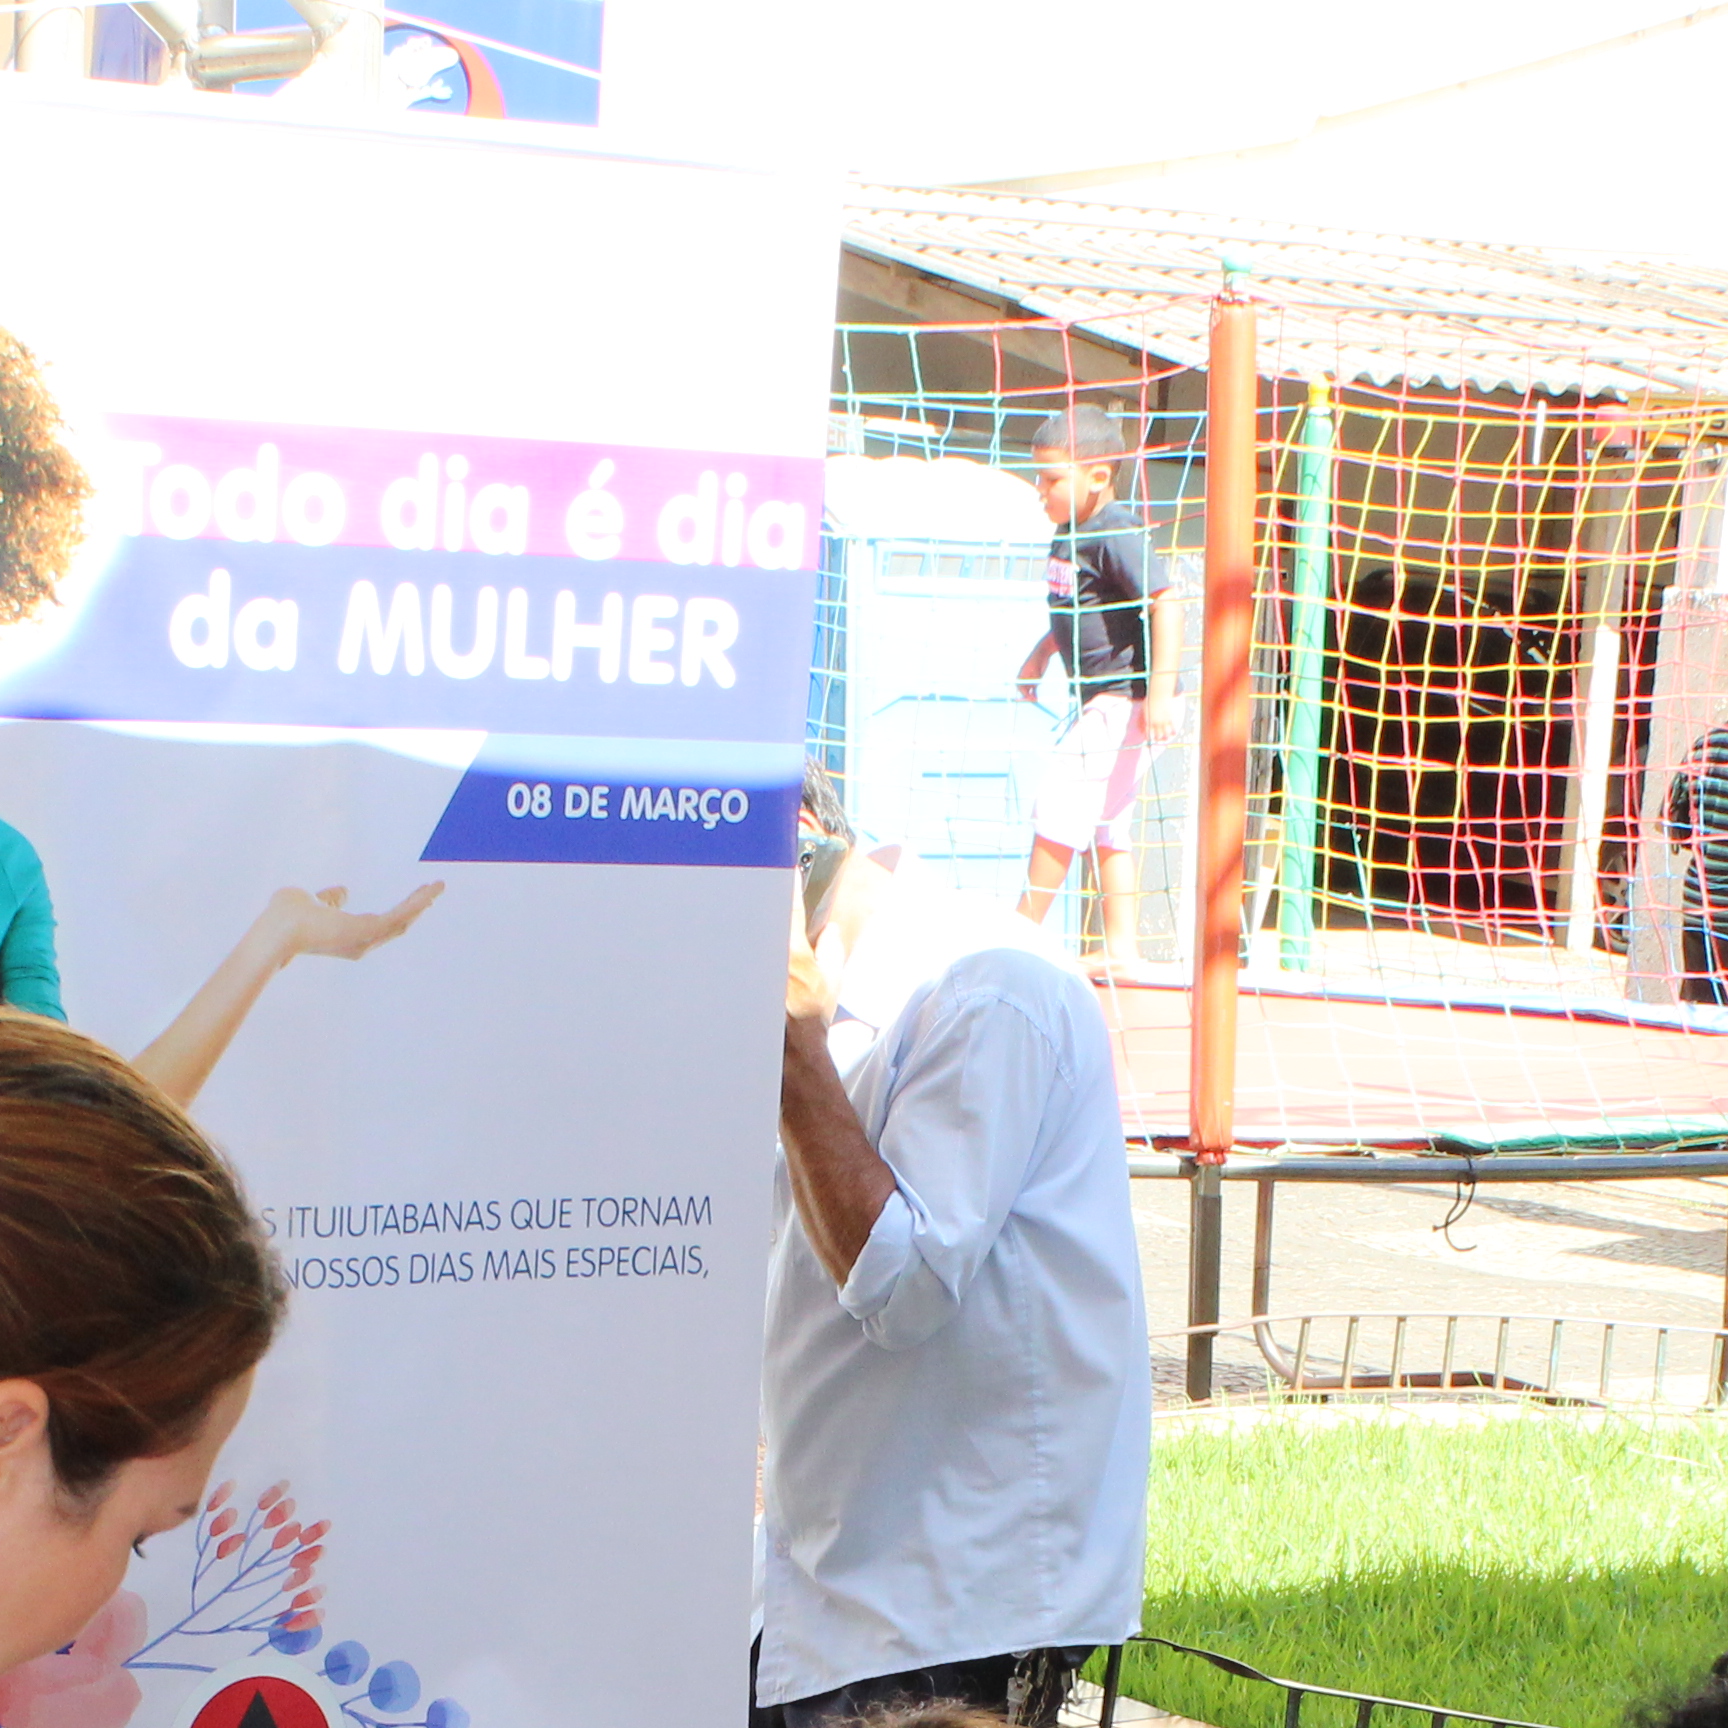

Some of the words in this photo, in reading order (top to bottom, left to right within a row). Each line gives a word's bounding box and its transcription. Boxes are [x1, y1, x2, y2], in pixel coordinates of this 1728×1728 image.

[126, 439, 348, 548] Todo
[379, 452, 531, 557] dia
[564, 457, 625, 561] é
[656, 470, 807, 572] dia
[169, 567, 299, 672] da
[337, 579, 741, 689] MULHER
[506, 781, 552, 820] 08
[564, 783, 610, 821] DE
[620, 786, 750, 833] MARÇO
[288, 1201, 501, 1240] ITUIUTABANAS
[510, 1198, 572, 1231] QUE
[583, 1195, 713, 1228] TORNAM
[409, 1252, 473, 1285] DIAS
[482, 1248, 556, 1282] MAIS
[565, 1245, 710, 1279] ESPECIAIS,
